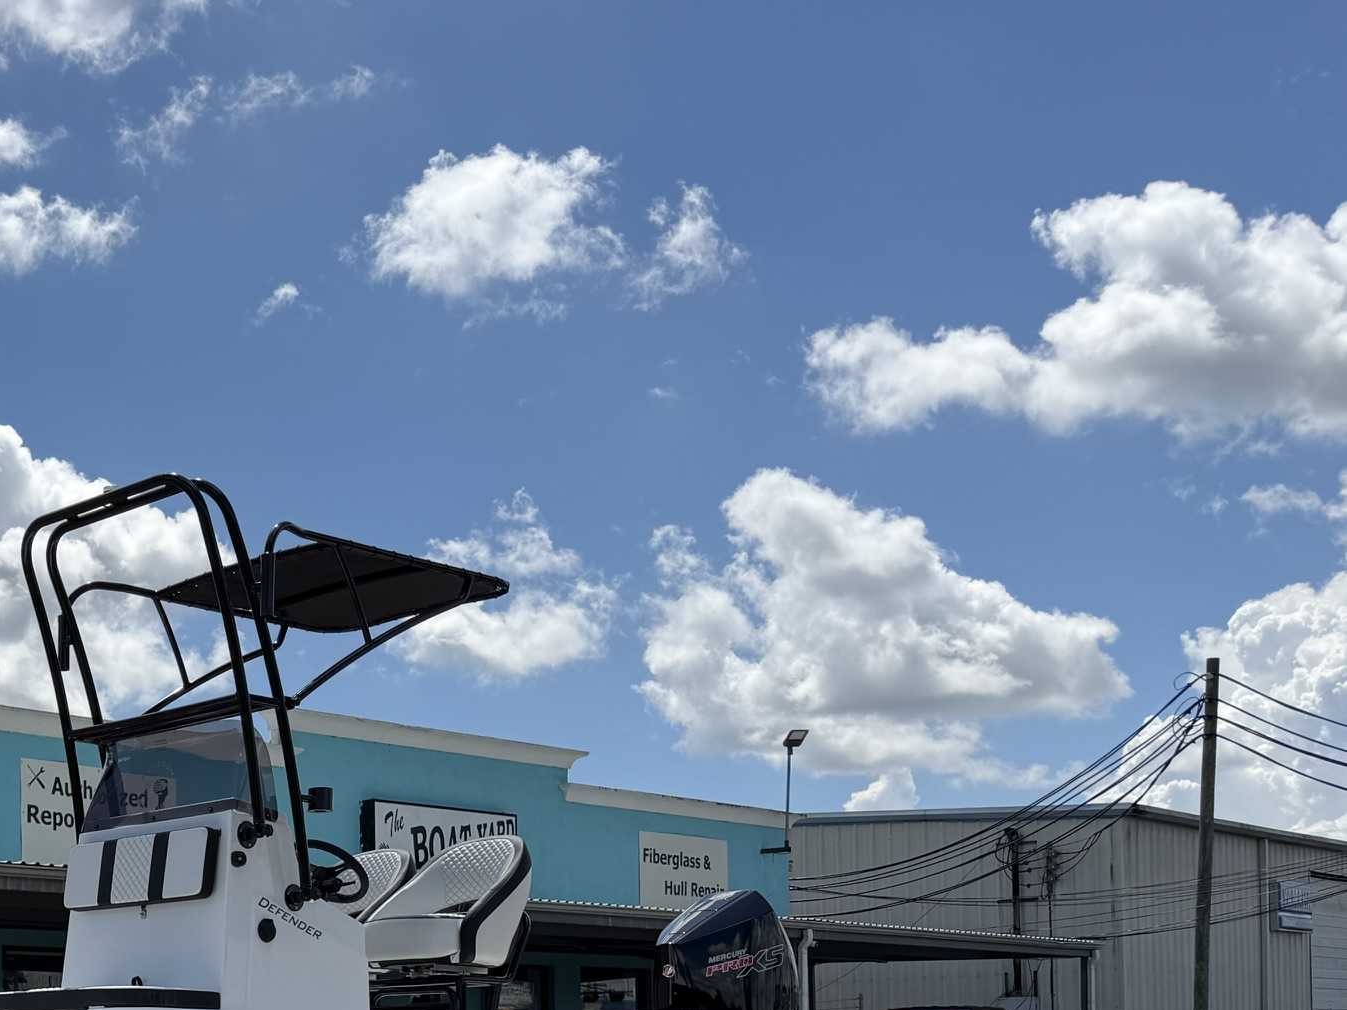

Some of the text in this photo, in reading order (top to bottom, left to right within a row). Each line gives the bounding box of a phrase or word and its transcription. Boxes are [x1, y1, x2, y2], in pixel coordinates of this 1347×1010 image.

[385, 808, 404, 838] The
[643, 847, 712, 870] Fiberglass &
[664, 880, 688, 897] Hull
[258, 896, 323, 940] DEFENDER
[708, 947, 748, 964] MERCURY
[736, 943, 784, 979] XS
